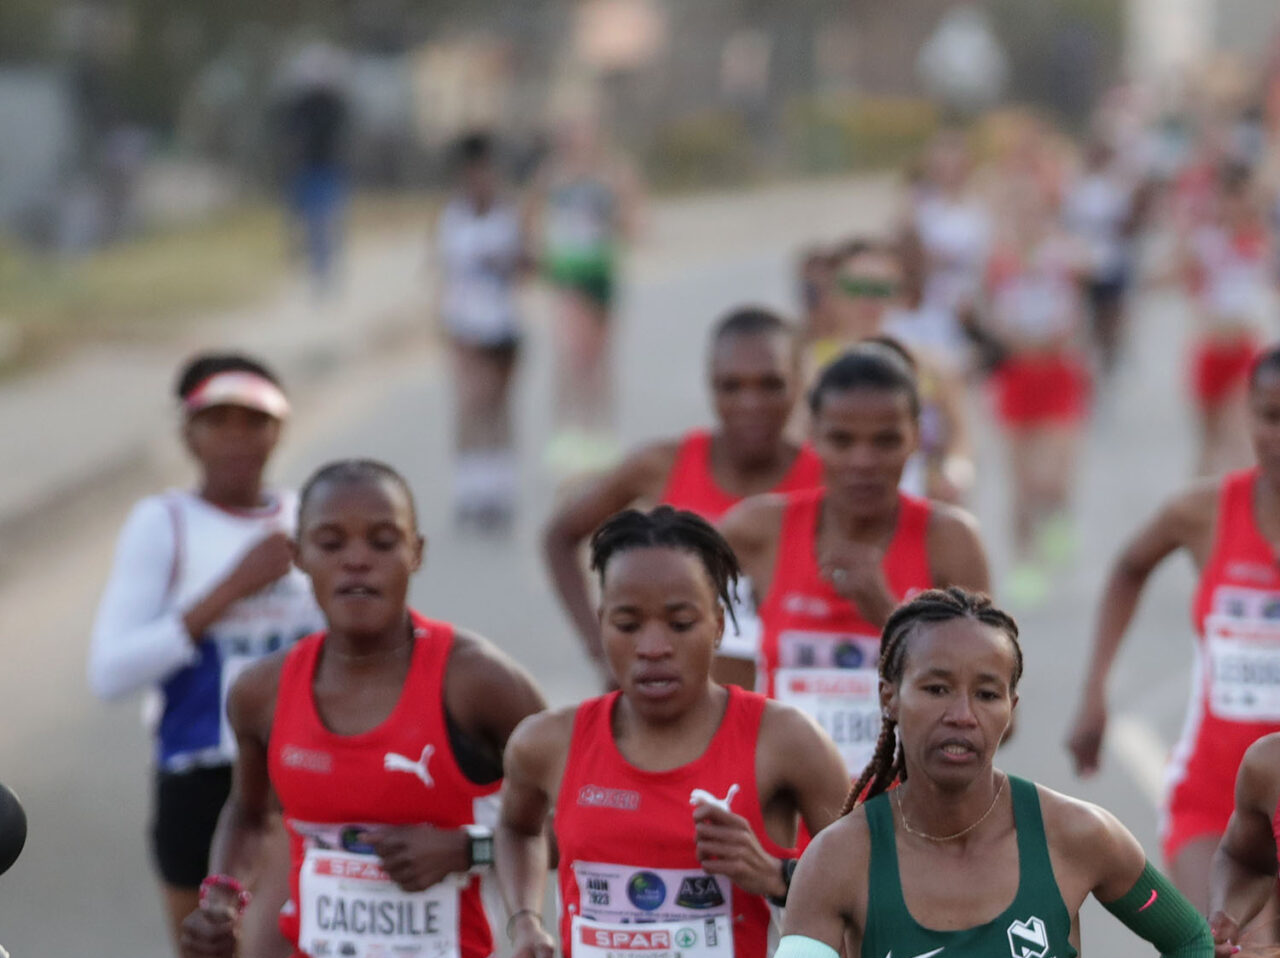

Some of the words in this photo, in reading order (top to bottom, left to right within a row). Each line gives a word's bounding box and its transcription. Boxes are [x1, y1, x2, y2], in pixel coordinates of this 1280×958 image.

[681, 879, 718, 895] ASA
[316, 895, 441, 935] CACISILE
[594, 931, 670, 949] SPAR
